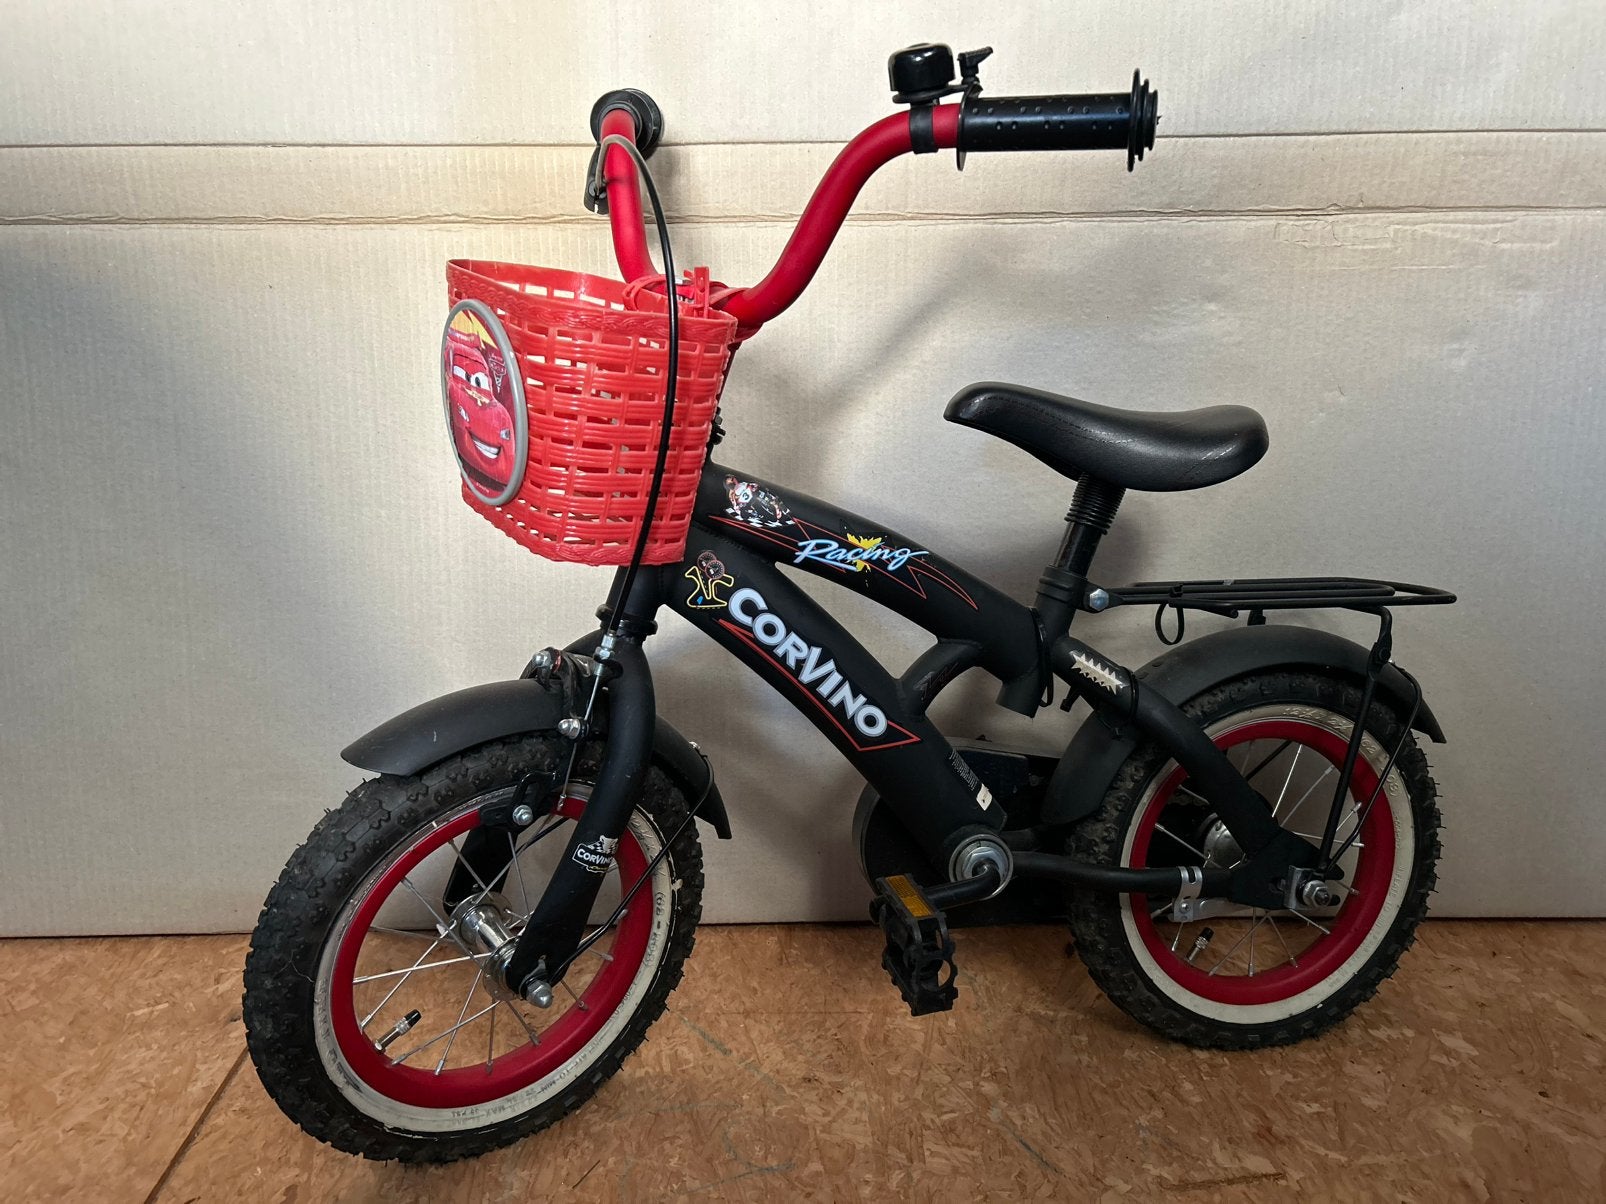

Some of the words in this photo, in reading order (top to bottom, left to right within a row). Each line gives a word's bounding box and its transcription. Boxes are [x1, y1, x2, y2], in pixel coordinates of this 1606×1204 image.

[793, 538, 929, 571] Racing
[728, 587, 888, 737] CORVINO
[576, 848, 612, 865] CORVIN
